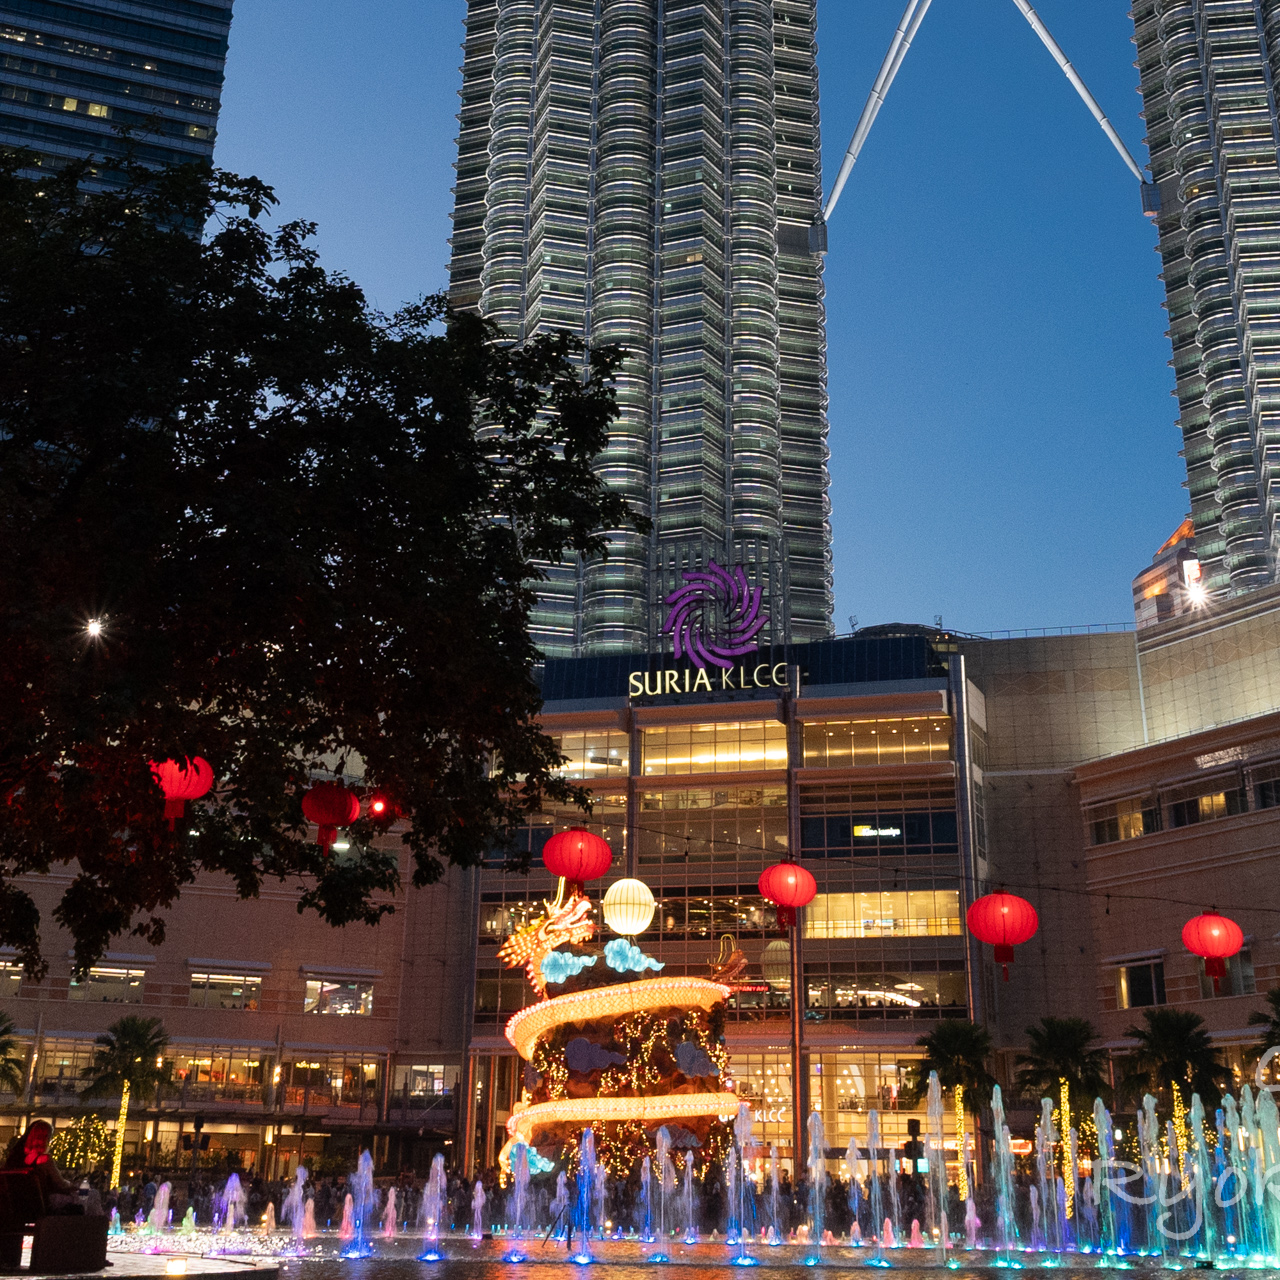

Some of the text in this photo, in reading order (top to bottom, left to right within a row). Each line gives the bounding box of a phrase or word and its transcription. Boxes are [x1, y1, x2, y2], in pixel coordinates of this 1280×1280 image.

[628, 662, 789, 697] SURIA KLCC
[754, 1109, 786, 1122] KLCC
